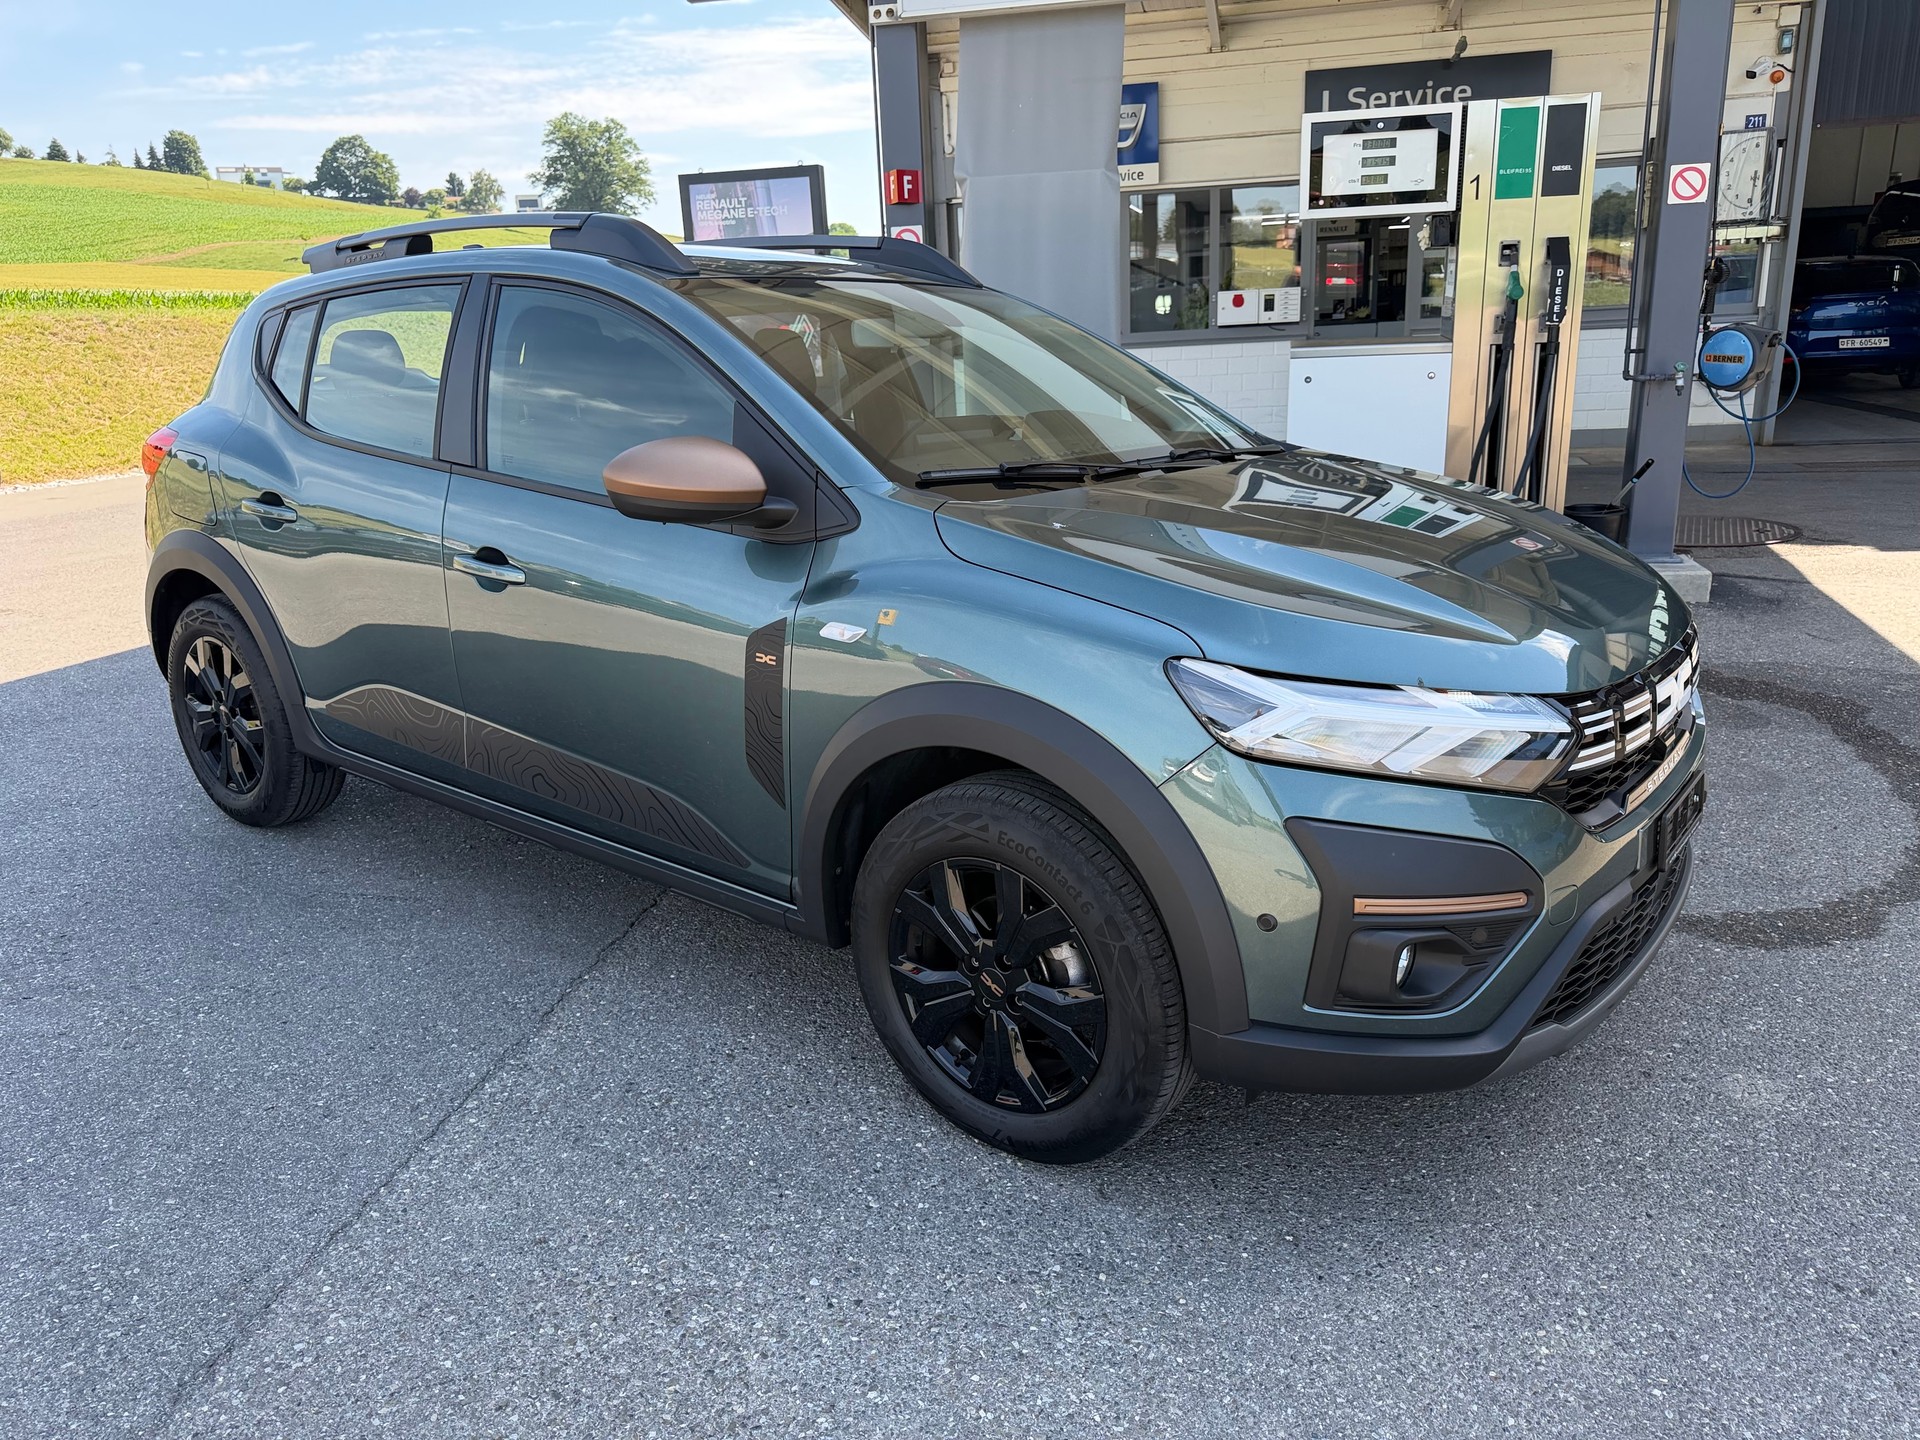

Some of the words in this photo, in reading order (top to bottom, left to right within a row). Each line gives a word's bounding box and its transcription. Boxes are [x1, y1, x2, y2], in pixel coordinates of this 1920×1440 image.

[1347, 80, 1472, 110] Service
[1120, 111, 1138, 119] CIA
[1748, 116, 1763, 128] 211
[1119, 169, 1144, 181] vice
[889, 175, 895, 200] F
[903, 175, 913, 199] F
[1470, 174, 1480, 200] 1
[696, 197, 747, 210] RENAULT
[697, 208, 746, 221] MEGANE
[747, 205, 788, 218] E-TECH
[1319, 225, 1348, 233] RENAULT
[1553, 268, 1564, 322] DIESEL
[1847, 299, 1889, 307] DACIA
[1846, 339, 1856, 347] FR
[1859, 338, 1883, 346] 60549
[1712, 355, 1743, 363] BERNER
[1647, 748, 1684, 792] STEPWAY
[997, 830, 1083, 903] EcoContact
[1080, 901, 1095, 915] 6
